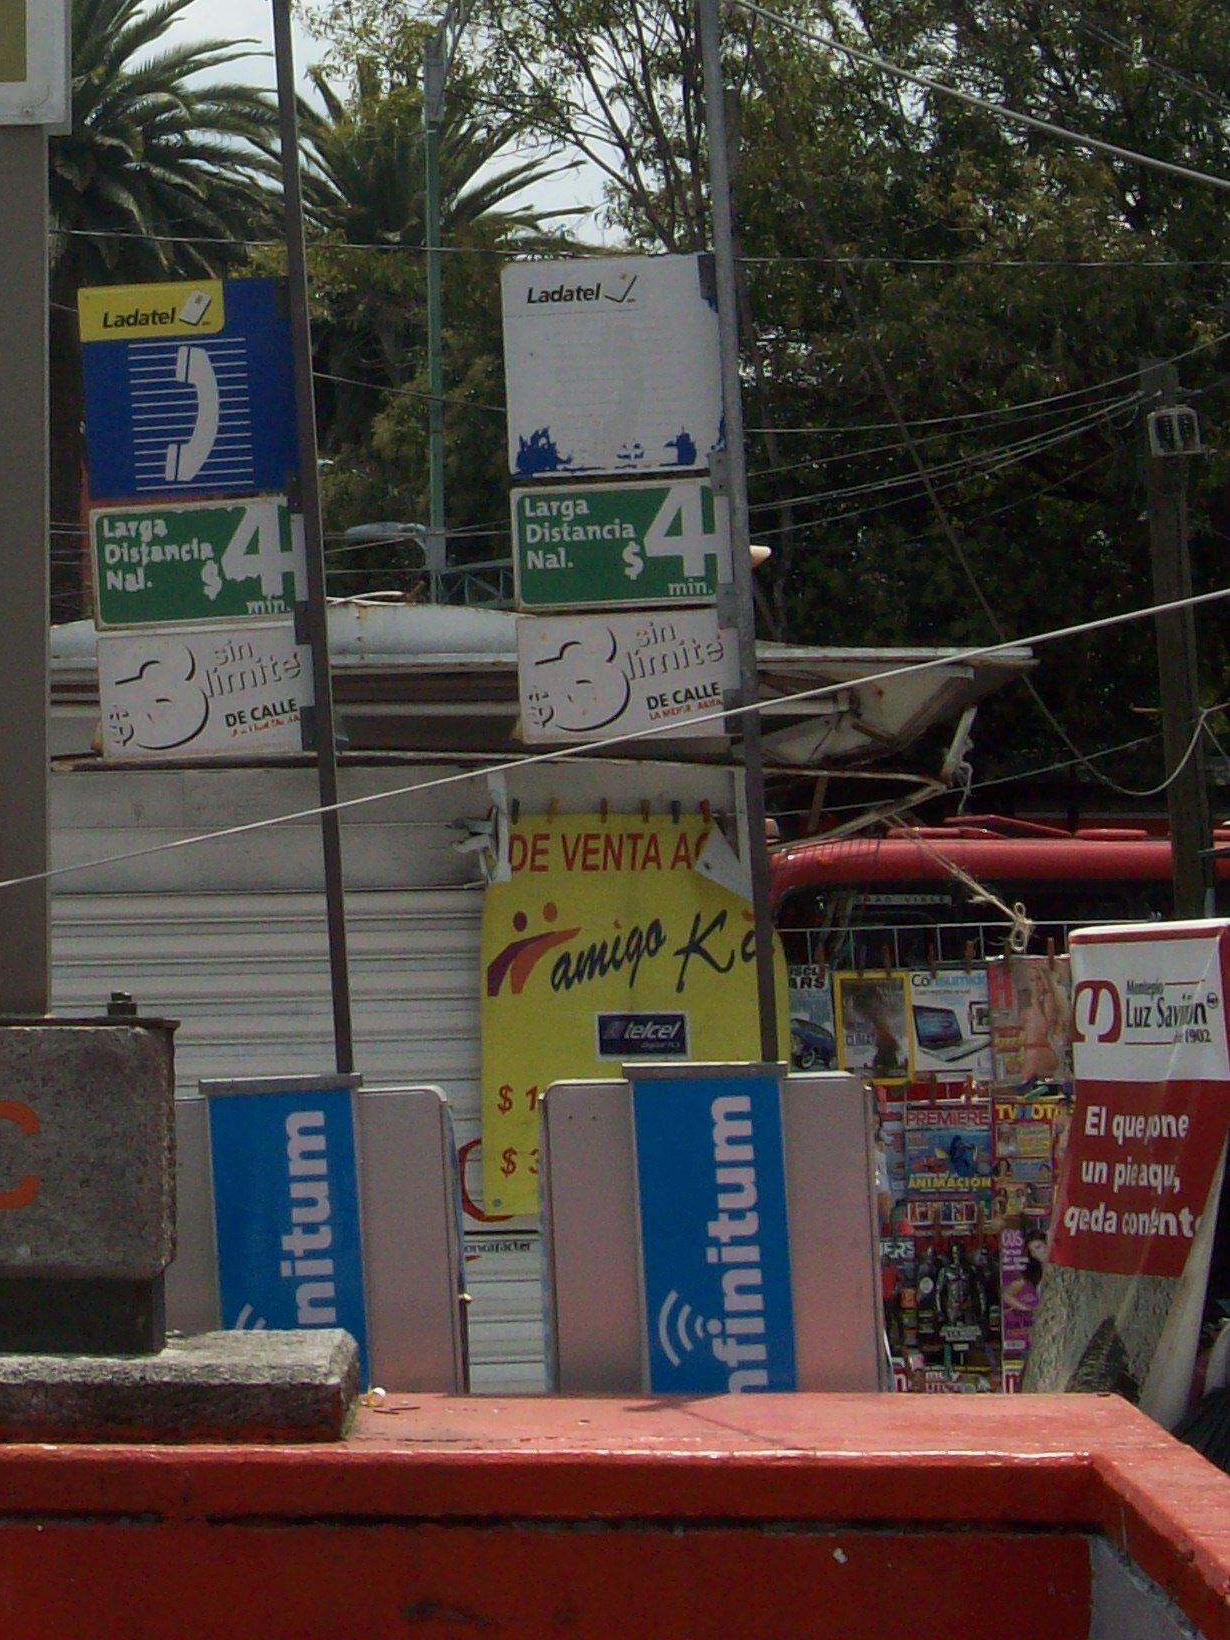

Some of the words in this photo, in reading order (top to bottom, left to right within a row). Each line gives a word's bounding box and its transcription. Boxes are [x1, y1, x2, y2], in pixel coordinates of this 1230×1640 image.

[526, 282, 602, 304] Ladatel
[101, 307, 177, 329] Ladatel
[524, 497, 590, 522] Larga
[103, 517, 169, 543] Larga
[525, 518, 636, 544] Distancia
[104, 537, 215, 566] Distancia
[526, 547, 574, 570] Nal.
[106, 567, 153, 592] Nal.
[668, 578, 714, 596] min.
[646, 693, 670, 710] DE
[672, 681, 721, 703] CALLE
[225, 710, 248, 728] DE
[250, 698, 299, 721] CALLE
[508, 832, 551, 873] DE
[561, 831, 662, 872] VENTA
[550, 918, 666, 993] amigo
[1126, 997, 1152, 1028] Luz
[623, 1020, 682, 1040] telcel
[906, 1110, 988, 1126] PREMIERE
[1084, 1105, 1107, 1137] El
[1112, 1114, 1145, 1146] que
[1081, 1160, 1109, 1184] un
[1113, 1155, 1137, 1194] pie
